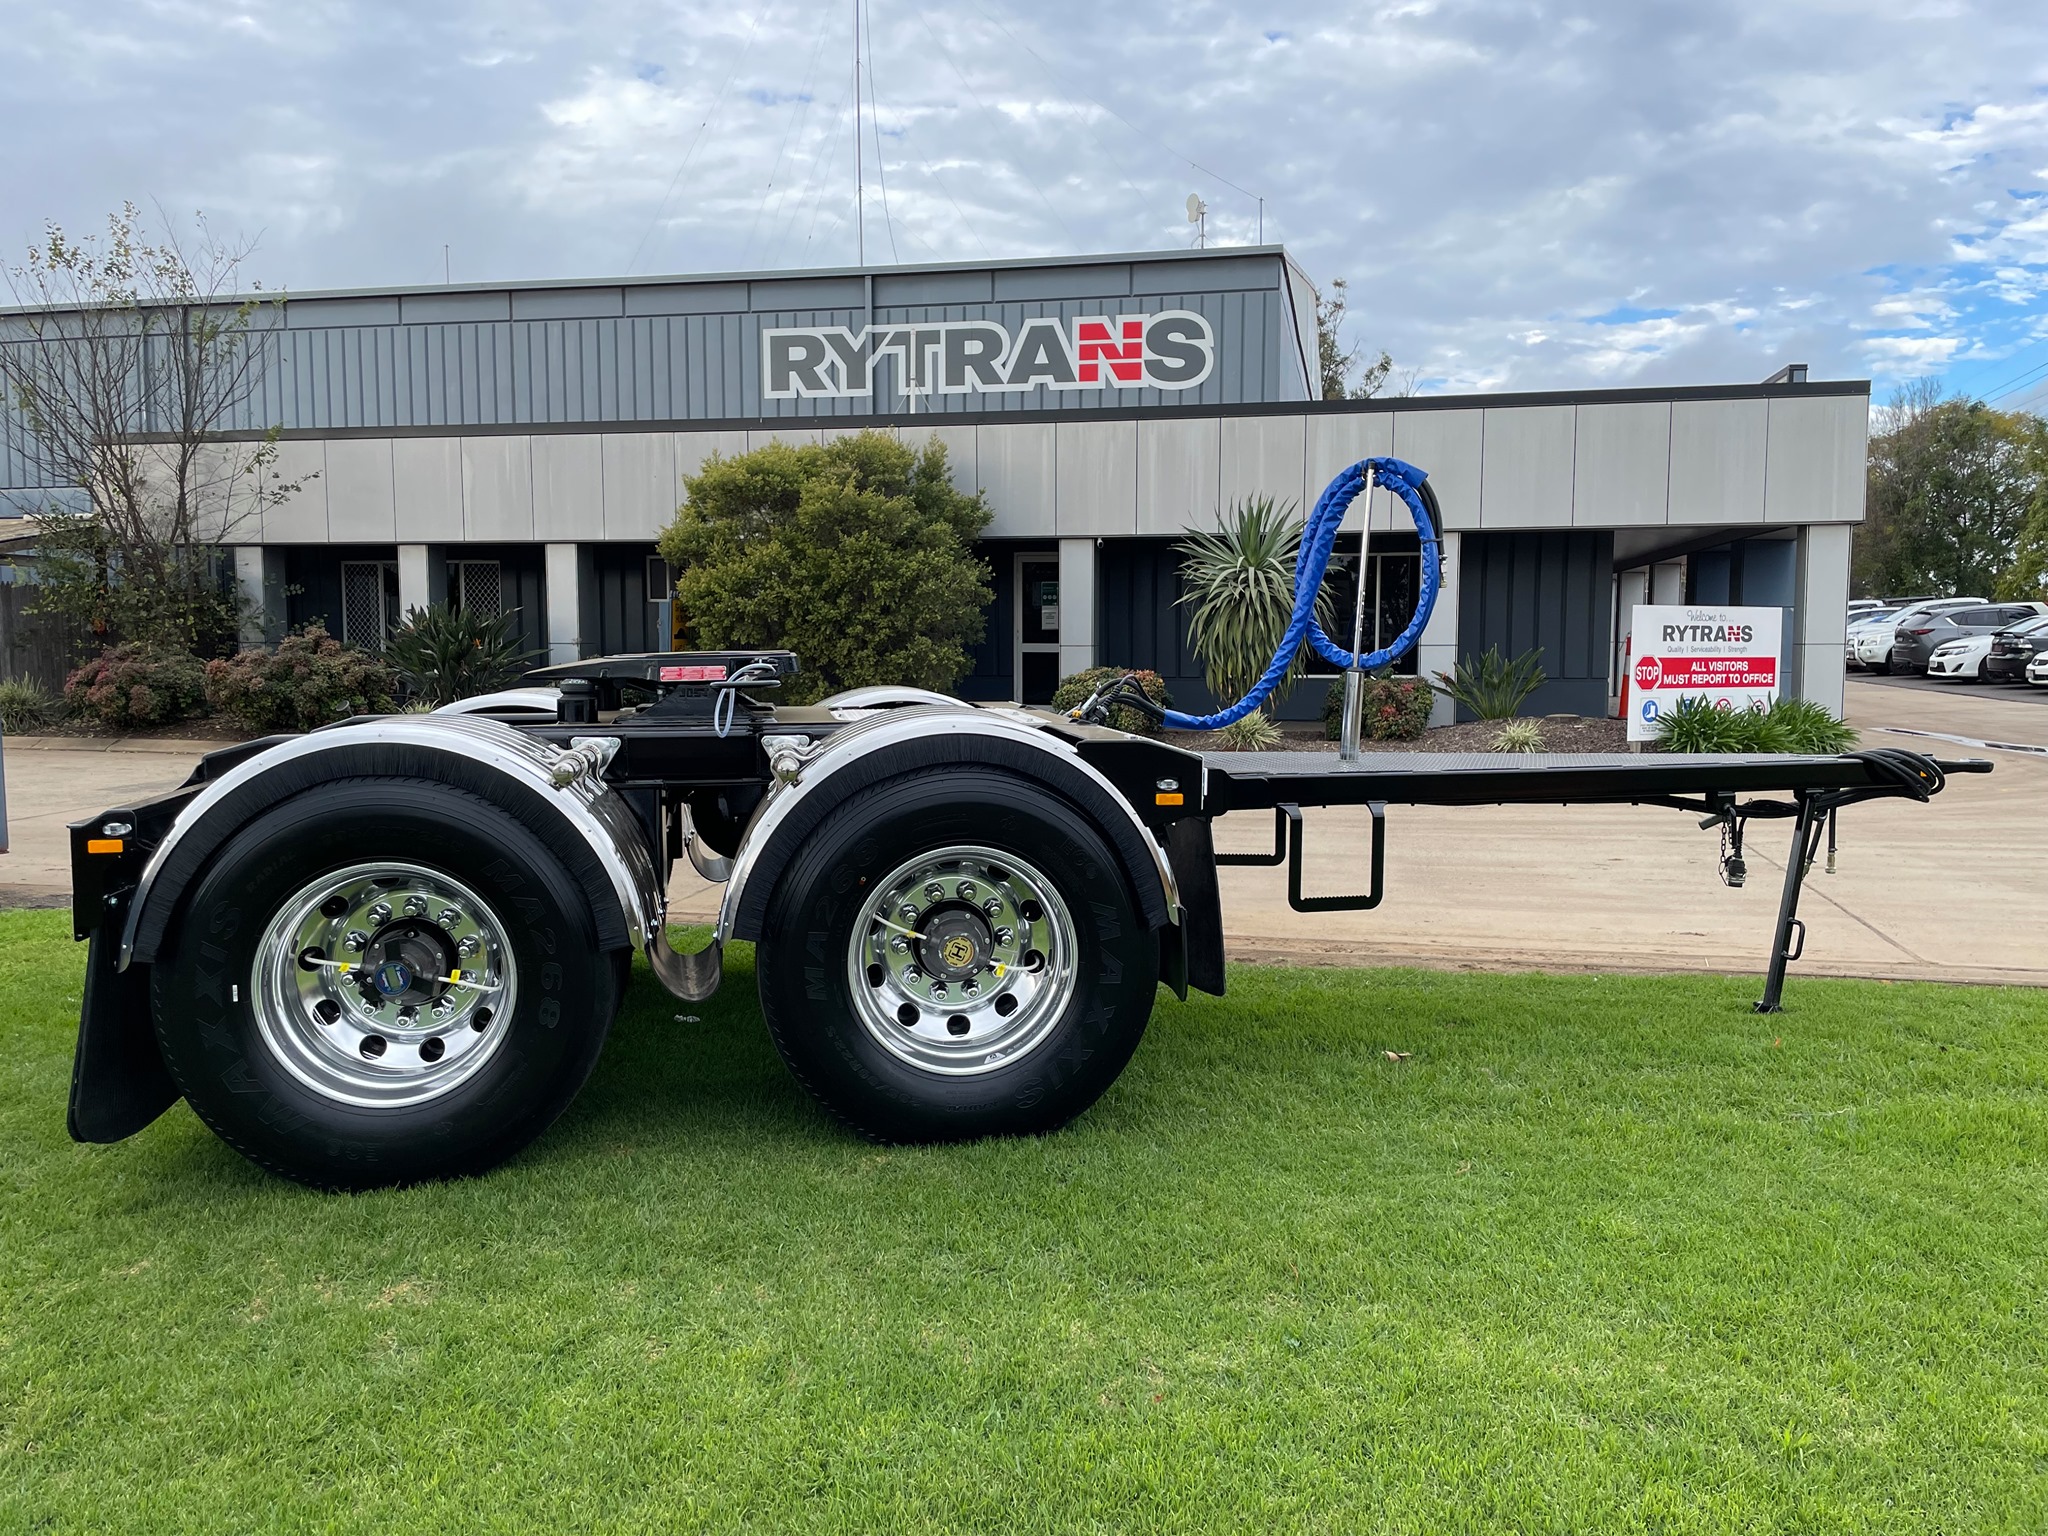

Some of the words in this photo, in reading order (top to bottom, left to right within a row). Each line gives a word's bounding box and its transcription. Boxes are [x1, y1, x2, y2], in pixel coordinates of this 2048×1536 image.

[765, 313, 1211, 396] RYTRANS
[1687, 610, 1717, 622] Welcome
[1662, 625, 1753, 642] RYTRANS
[1636, 666, 1659, 681] STOP
[1691, 661, 1706, 671] ALL
[1708, 661, 1748, 671] VISITORS
[1663, 674, 1690, 684] MUST
[1691, 673, 1727, 684] REPORT
[1728, 673, 1740, 684] TO
[1742, 673, 1773, 684] OFFICE
[482, 858, 565, 1029] MA268
[1015, 900, 1124, 1109] MAXXIS
[195, 900, 317, 1135] MAXXIS
